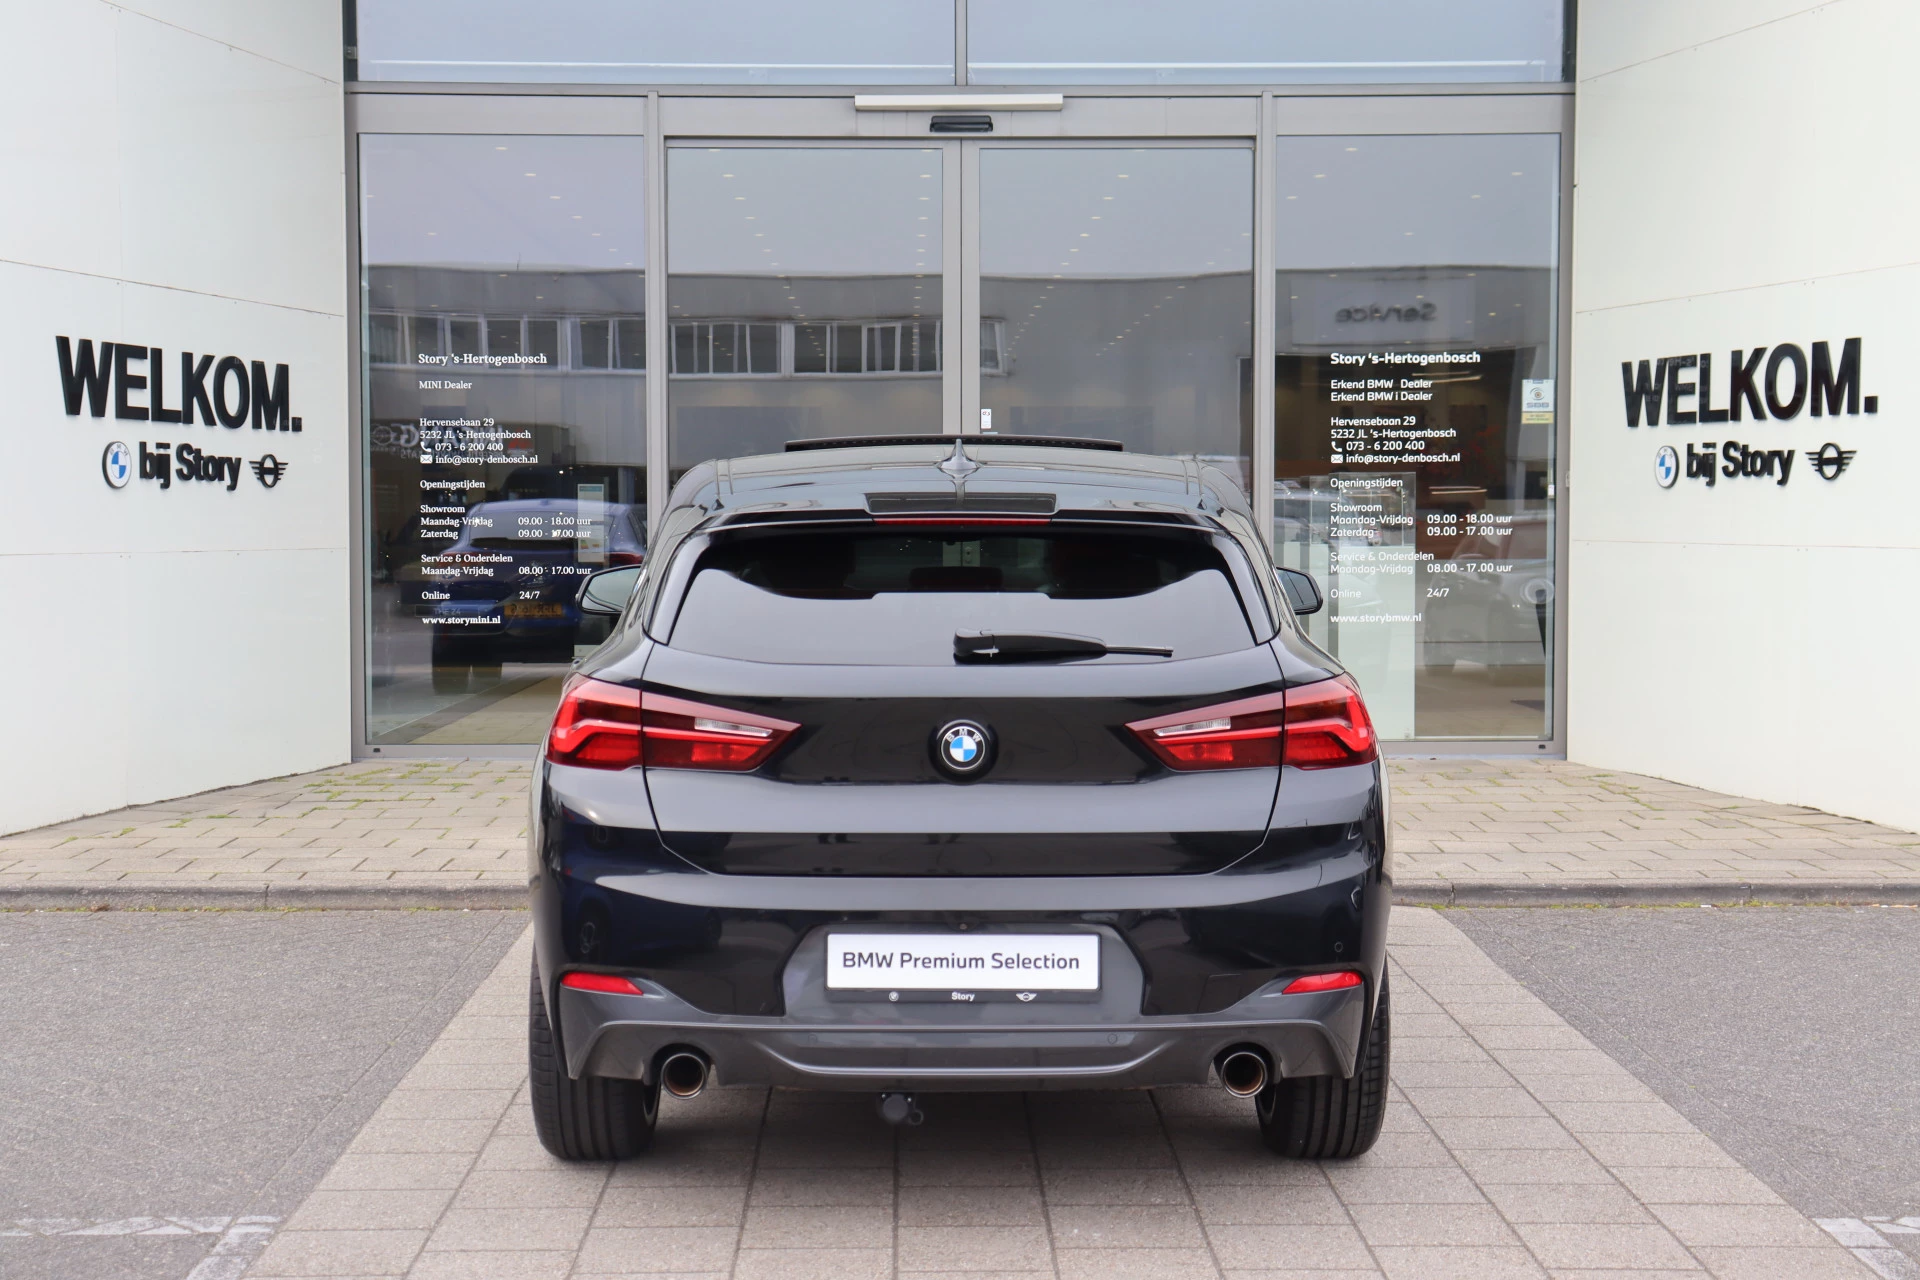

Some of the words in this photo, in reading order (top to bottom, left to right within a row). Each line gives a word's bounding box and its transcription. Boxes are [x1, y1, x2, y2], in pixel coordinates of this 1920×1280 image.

[418, 354, 448, 366] Story
[1331, 352, 1366, 366] Story
[56, 336, 302, 432] WELKOM.
[419, 381, 442, 389] MINI
[444, 381, 472, 389] Dealer
[1331, 380, 1365, 389] Erkend
[1367, 380, 1394, 388] BMW
[1401, 379, 1432, 388] Dealer
[1622, 337, 1878, 427] WELKOM.
[1331, 392, 1365, 401] Erkend
[1367, 392, 1394, 401] BMW
[1401, 392, 1432, 401] Dealer
[420, 418, 480, 426] Hervensebaan
[483, 418, 494, 426] 29
[1331, 416, 1400, 426] Hervensebaan
[1403, 416, 1416, 425] 29
[420, 430, 442, 438] 5232
[444, 430, 454, 439] JL
[1331, 429, 1354, 438] 5232
[1357, 429, 1368, 438] JL
[435, 442, 452, 451] 073
[460, 442, 464, 451] 6
[468, 442, 484, 451] 200
[486, 442, 503, 451] 400
[1346, 442, 1364, 450] 073
[1374, 442, 1380, 450] 6
[1383, 441, 1402, 450] 200
[1405, 441, 1424, 450] 400
[436, 454, 538, 466] info@story-denbosch.nl
[1346, 453, 1460, 464] info@story-denbosch.nl
[1687, 443, 1716, 486] bij
[1722, 441, 1795, 485] Story
[139, 441, 170, 489] bij
[176, 443, 241, 491] Story
[420, 480, 485, 490] Openingstijden
[1331, 478, 1402, 489] Openingstijden
[420, 505, 465, 514] Showroom
[1331, 503, 1382, 512] Showroom
[421, 517, 492, 528] Maandag-Vrijdag
[518, 517, 542, 526] 09.00
[551, 517, 574, 526] 18.00
[576, 518, 592, 526] uur
[1331, 515, 1413, 526] Maandag-Vrijdag
[1427, 514, 1457, 524] 09.00
[1466, 514, 1493, 524] 18.00
[421, 530, 458, 540] Zaterdag
[518, 530, 542, 538] 09.00
[552, 530, 574, 538] 17.00
[1331, 528, 1374, 538] Zaterdag
[1427, 527, 1457, 536] 09.00
[1466, 526, 1494, 536] 17.00
[421, 554, 453, 563] Service
[456, 554, 462, 562] &
[464, 554, 513, 563] Onderdelen
[1331, 552, 1366, 561] Service
[1368, 552, 1376, 561] &
[1378, 552, 1434, 561] Onderdelen
[422, 566, 494, 577] Maandag-Vrijdag
[519, 566, 543, 575] 08.00
[552, 566, 574, 575] 17.00
[1331, 564, 1413, 575] Maandag-Vrijdag
[1427, 564, 1457, 573] 08.00
[1466, 563, 1494, 572] 17.00
[422, 591, 450, 600] Online
[520, 590, 540, 600] 24/7
[1331, 589, 1362, 598] Online
[1427, 588, 1449, 598] 24/7
[422, 616, 500, 627] www.storymini.nl
[1331, 613, 1421, 624] www.storybmw.nl
[945, 728, 982, 743] BMW
[843, 952, 893, 968] BMW
[900, 953, 985, 969] Premium
[992, 953, 1079, 969] Selection
[952, 992, 975, 1001] Story
